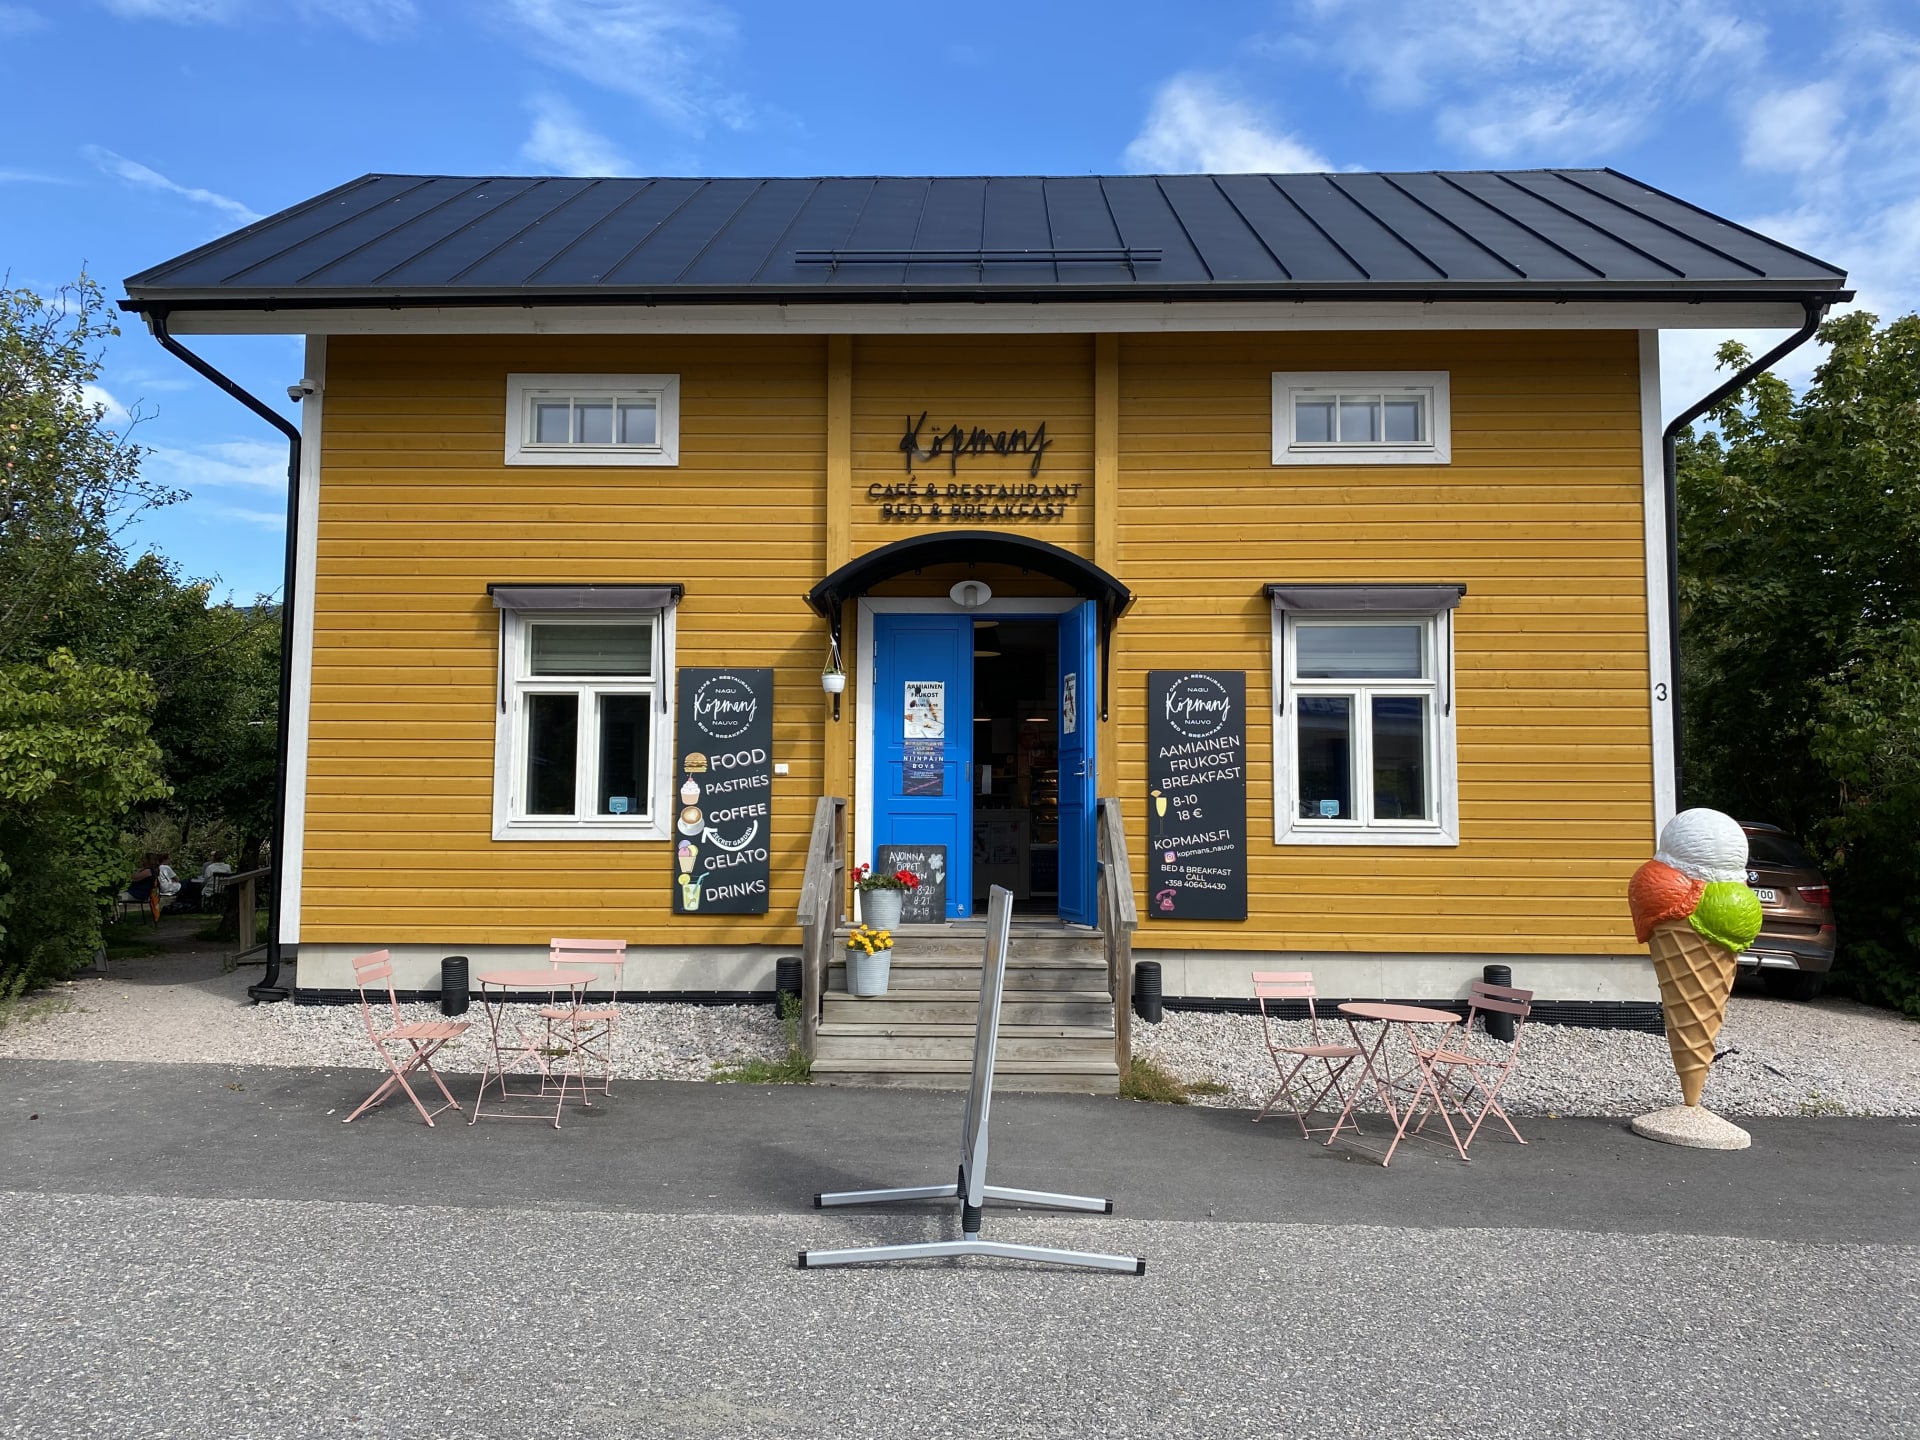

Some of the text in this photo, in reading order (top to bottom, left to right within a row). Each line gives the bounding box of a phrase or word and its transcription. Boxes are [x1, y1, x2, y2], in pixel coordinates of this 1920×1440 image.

[868, 476, 1082, 499] CAFÉ & RESTAURANT
[883, 503, 1068, 519] BED & BREAKFAST
[1655, 682, 1668, 702] 3
[1159, 735, 1241, 758] AAMIAINEN
[710, 748, 767, 771] FOOD
[1170, 751, 1235, 772] FRUKOST
[705, 774, 769, 795] PASTRIES
[1162, 767, 1241, 789] BREAKFAST
[1172, 794, 1198, 807] 8-10
[709, 803, 767, 823] COFFEE
[1176, 808, 1203, 821] 18 €
[712, 826, 753, 847] SECRET GARDEN
[1154, 829, 1230, 850] KOPMANS.FI
[704, 848, 768, 870] GELATO
[889, 852, 925, 864] AVOINNA
[1176, 843, 1235, 857] kopmans_nauvo
[1160, 864, 1232, 876] BED & BREAKFAST
[705, 880, 766, 902] DRINKS
[1164, 879, 1183, 887] +358
